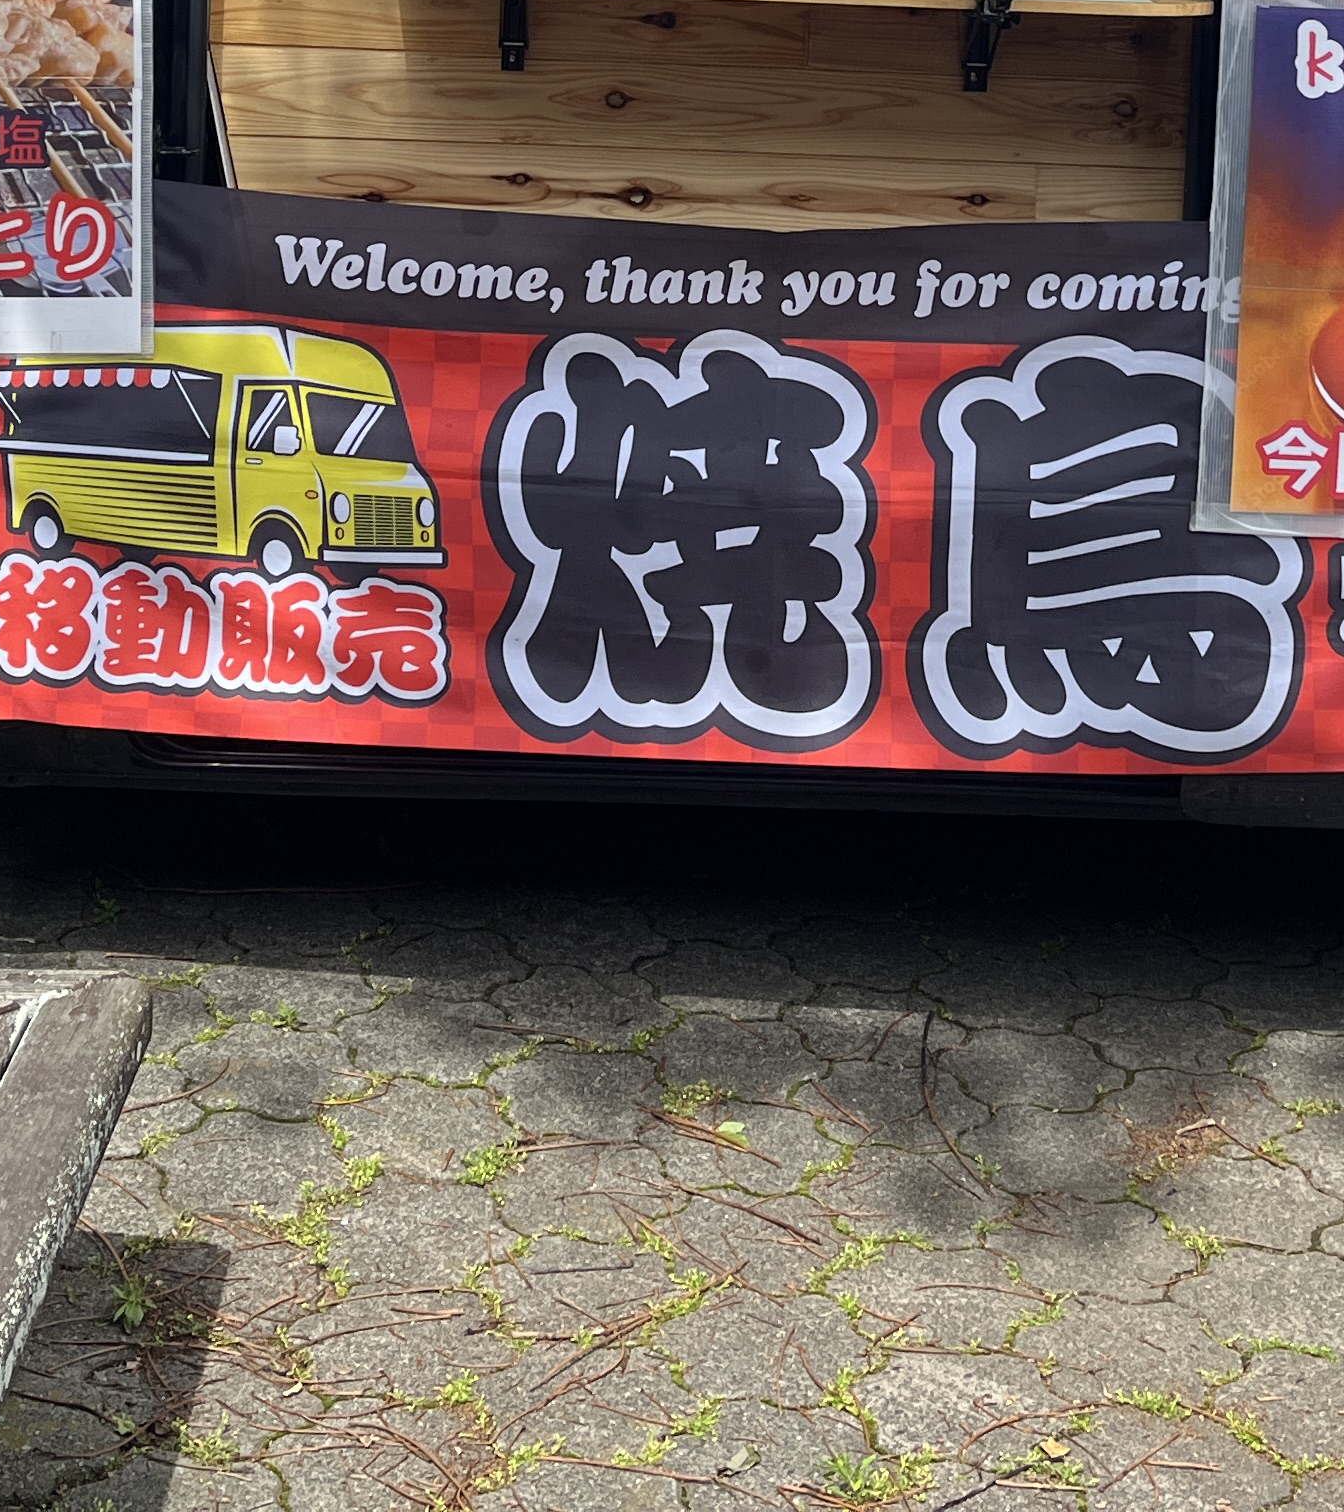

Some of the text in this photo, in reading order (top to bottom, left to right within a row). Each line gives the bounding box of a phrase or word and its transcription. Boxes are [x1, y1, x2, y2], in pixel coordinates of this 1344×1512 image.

[276, 233, 567, 311] Welcome,
[586, 256, 765, 306] thank
[782, 268, 897, 319] you
[913, 258, 1019, 320] for
